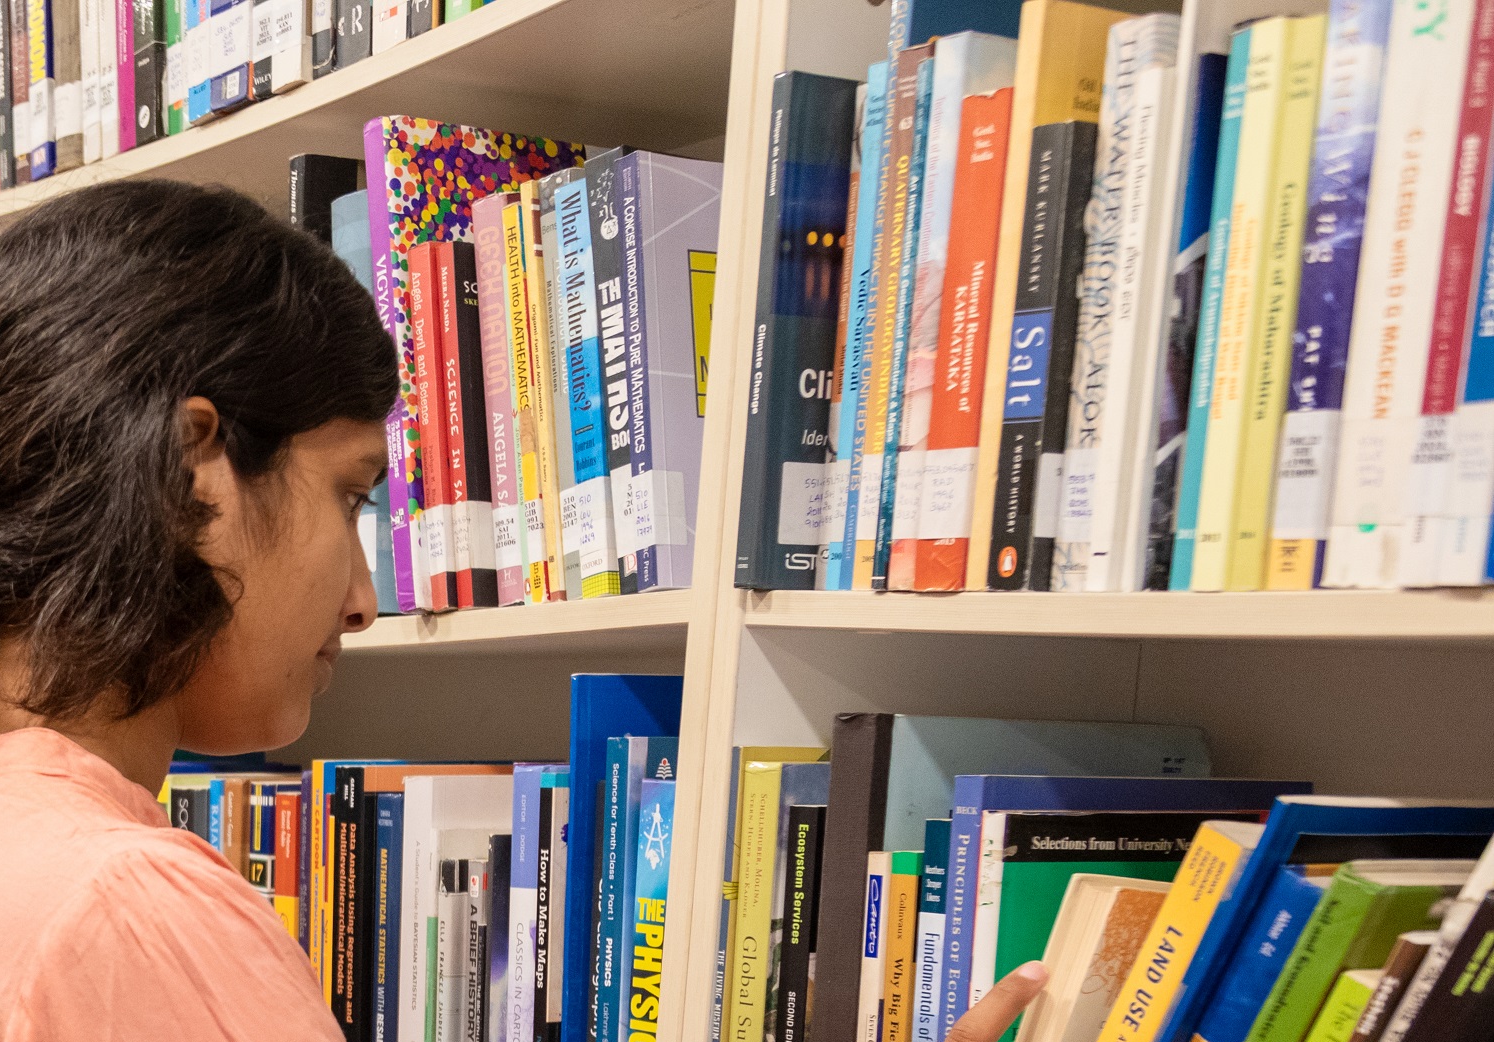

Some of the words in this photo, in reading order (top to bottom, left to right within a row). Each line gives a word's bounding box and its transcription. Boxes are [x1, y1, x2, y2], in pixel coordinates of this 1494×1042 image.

[254, 74, 272, 86] WILEY
[1037, 151, 1053, 193] MARK
[559, 188, 583, 248] What
[624, 205, 636, 247] CONCISE
[507, 226, 519, 280] HEALTH
[564, 248, 585, 270] is
[1028, 201, 1047, 292] KURLANSKY
[375, 254, 390, 329] VIGYAN
[411, 272, 421, 317] Angels,
[511, 282, 522, 308] into
[625, 248, 638, 315] INTRODUCTION
[414, 318, 424, 346] Devil
[565, 270, 593, 413] Mathematics?
[946, 286, 969, 392] KARNATAKA
[417, 348, 426, 373] and
[513, 310, 531, 411] MATHEMATICS
[1007, 325, 1046, 407] Salt
[418, 373, 429, 426] Science
[445, 358, 459, 436] SCIENCE
[630, 370, 646, 454] MATHEMATICS
[451, 444, 461, 470] IN
[492, 412, 508, 486] ANGELA
[1010, 445, 1023, 484] WORLD
[1006, 486, 1019, 534] HISTORY
[611, 763, 620, 803] Science
[610, 805, 618, 819] for
[956, 806, 979, 815] BECK
[610, 820, 618, 852] Tenth
[793, 823, 809, 889] Ecosystem
[1030, 835, 1088, 852] Selections
[1088, 836, 1116, 851] from
[1117, 837, 1174, 854] University
[348, 852, 356, 893] Analysis
[379, 848, 388, 925] MATHEMATICAL
[540, 849, 549, 883] How
[608, 853, 616, 880] Class
[951, 834, 970, 935] PRINCIPLES
[347, 896, 355, 934] Using
[539, 886, 547, 902] to
[637, 896, 666, 923] THE
[538, 905, 547, 945] Make
[791, 891, 805, 945] Services
[378, 929, 386, 984] STATISTICS
[469, 920, 478, 966] BRIEF
[515, 922, 524, 981] CLASSICS
[604, 937, 614, 988] PHYSICS
[950, 940, 960, 966] OF
[1146, 924, 1184, 985] LAND
[336, 952, 345, 995] Models
[537, 949, 546, 989] Maps
[738, 935, 758, 1008] Global
[889, 958, 904, 988] Why
[918, 932, 940, 1024] Fundamentals
[346, 999, 354, 1024] and
[377, 986, 385, 1012] WITH
[467, 971, 477, 1042] HISTORY
[786, 991, 796, 1028] SECOND
[888, 993, 902, 1015] Big
[1122, 988, 1154, 1033] USE
[918, 1027, 931, 1042] of
